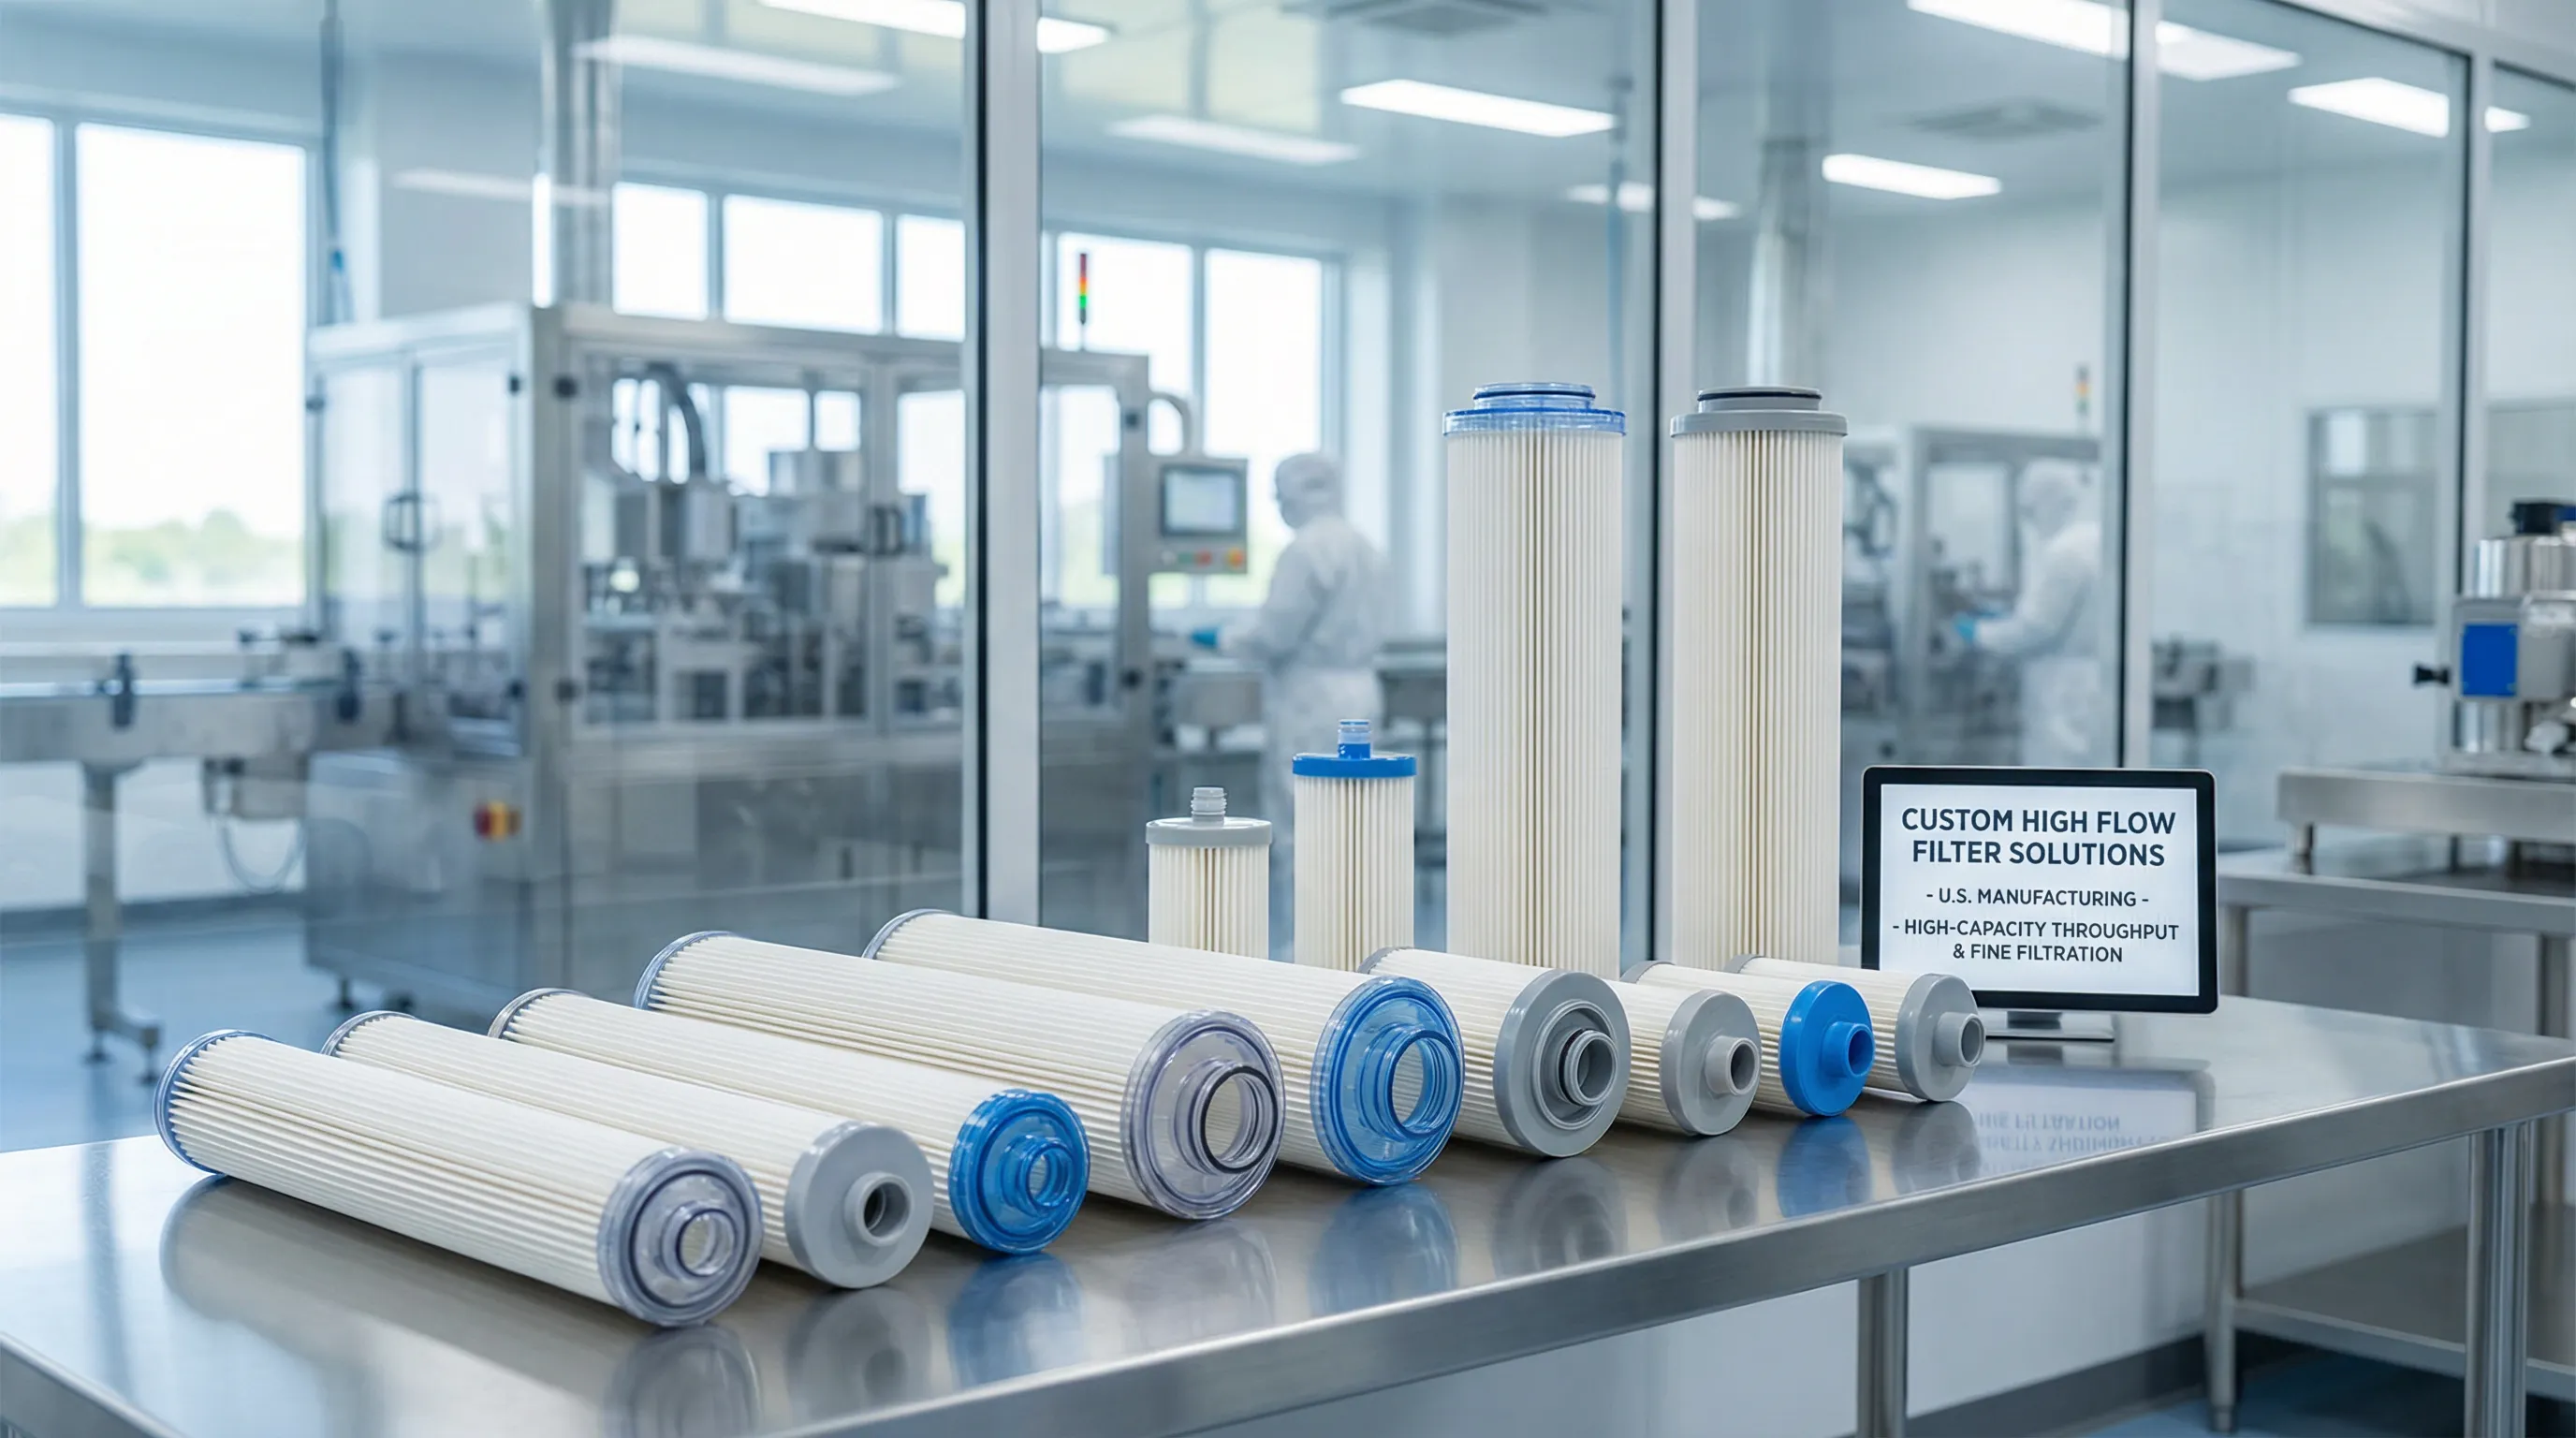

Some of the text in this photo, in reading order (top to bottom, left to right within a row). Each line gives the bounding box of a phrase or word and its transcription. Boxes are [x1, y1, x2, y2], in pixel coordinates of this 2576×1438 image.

[1901, 807, 2176, 835] CUSTOM HIGH FLOW
[1912, 840, 2165, 867] FILTER SOLUTIONS
[1939, 888, 1972, 904] U.S.
[1977, 888, 2137, 907] MANUFACTURING
[1904, 918, 2047, 937] HIGH-CAPACITY
[2051, 921, 2180, 941] THROUGHPUT
[1953, 943, 2123, 962] & FINE FILTRATION
